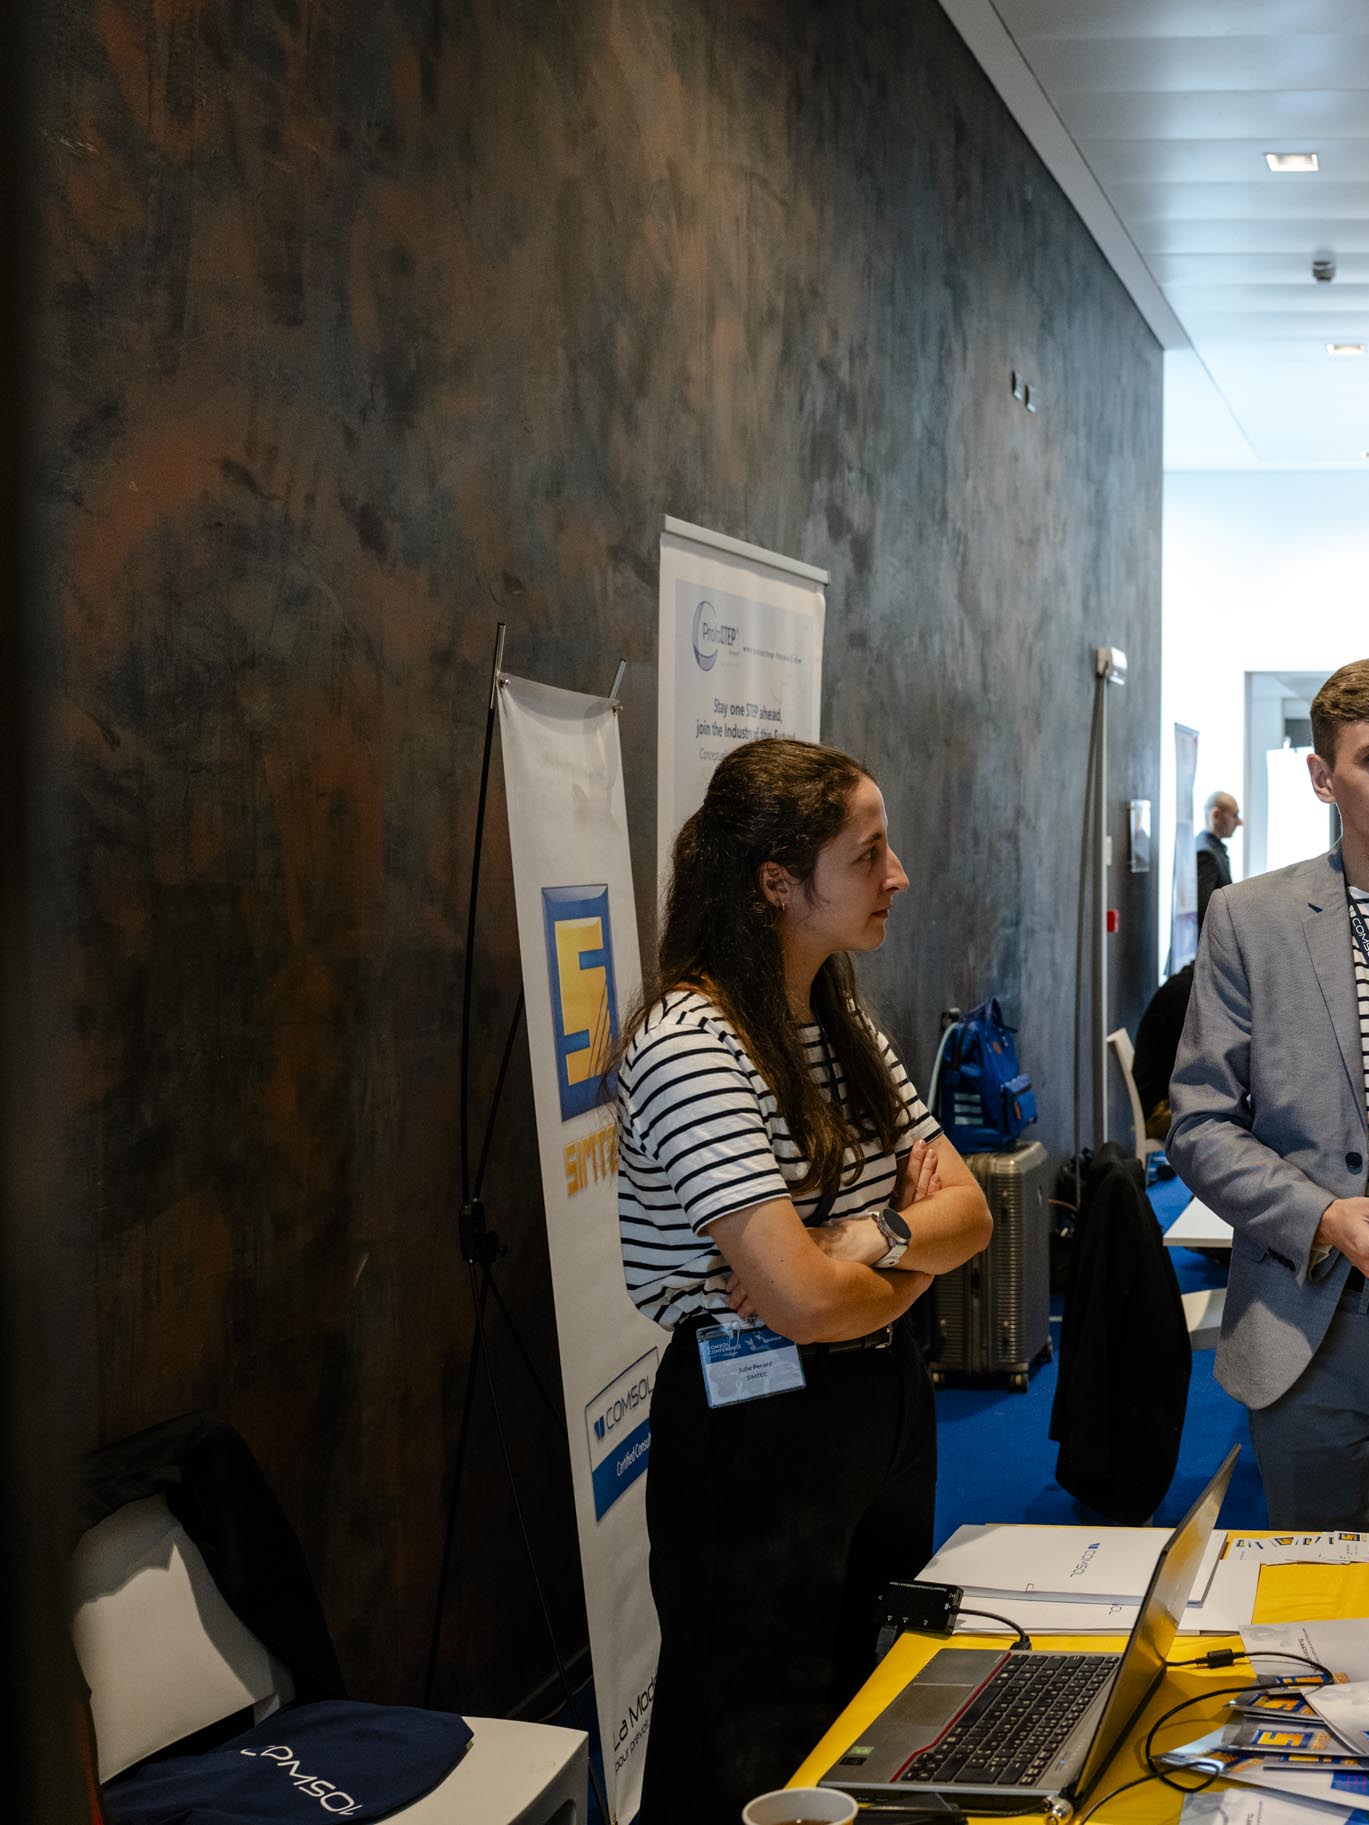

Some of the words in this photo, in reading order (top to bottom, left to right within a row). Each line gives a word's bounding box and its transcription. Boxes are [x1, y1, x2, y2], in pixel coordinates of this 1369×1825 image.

[713, 698, 728, 718] Stay
[730, 704, 745, 716] one
[696, 719, 711, 738] join
[712, 721, 722, 737] the
[606, 1376, 654, 1430] COMSOL
[613, 1719, 628, 1752] La
[628, 1676, 656, 1728] Mod
[615, 1747, 629, 1774] pour
